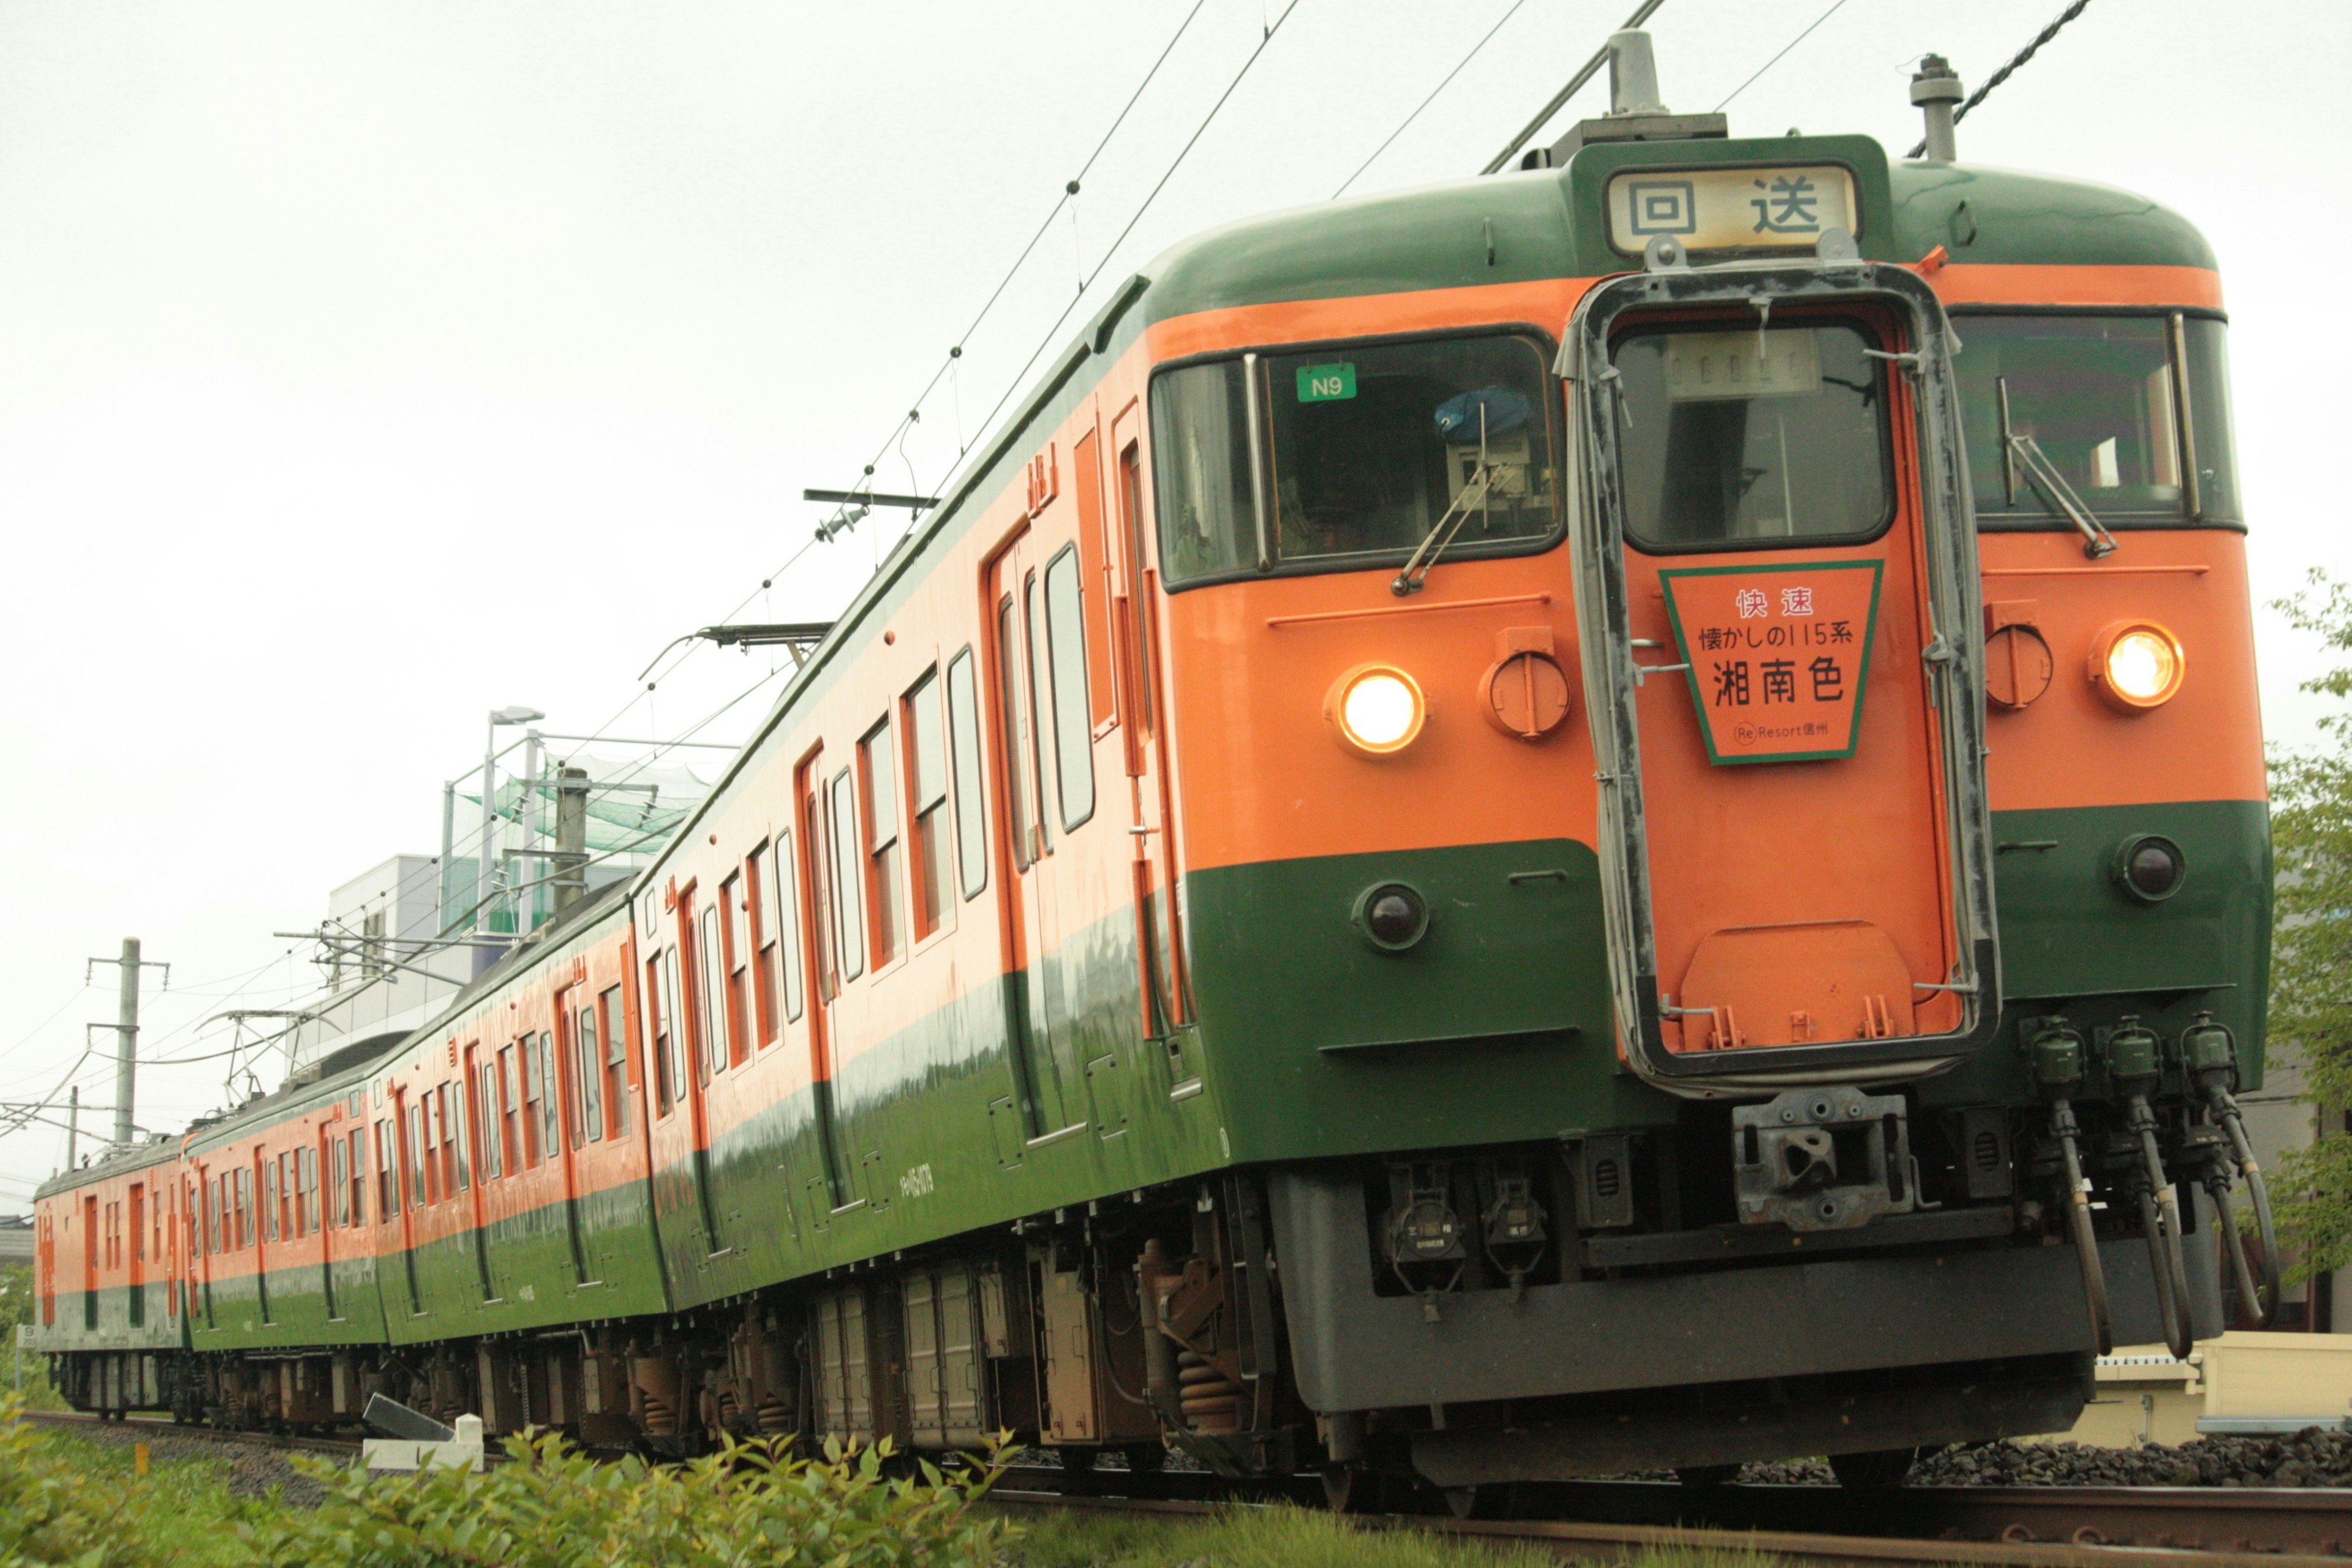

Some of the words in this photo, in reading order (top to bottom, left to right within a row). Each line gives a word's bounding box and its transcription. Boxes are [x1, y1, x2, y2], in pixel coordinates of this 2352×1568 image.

[1629, 176, 1820, 235] 回送
[1312, 377, 1342, 396] N9
[1736, 587, 1813, 618] 快速
[1698, 620, 1853, 651] 懐かしの115系
[1713, 656, 1844, 707] 湘南色
